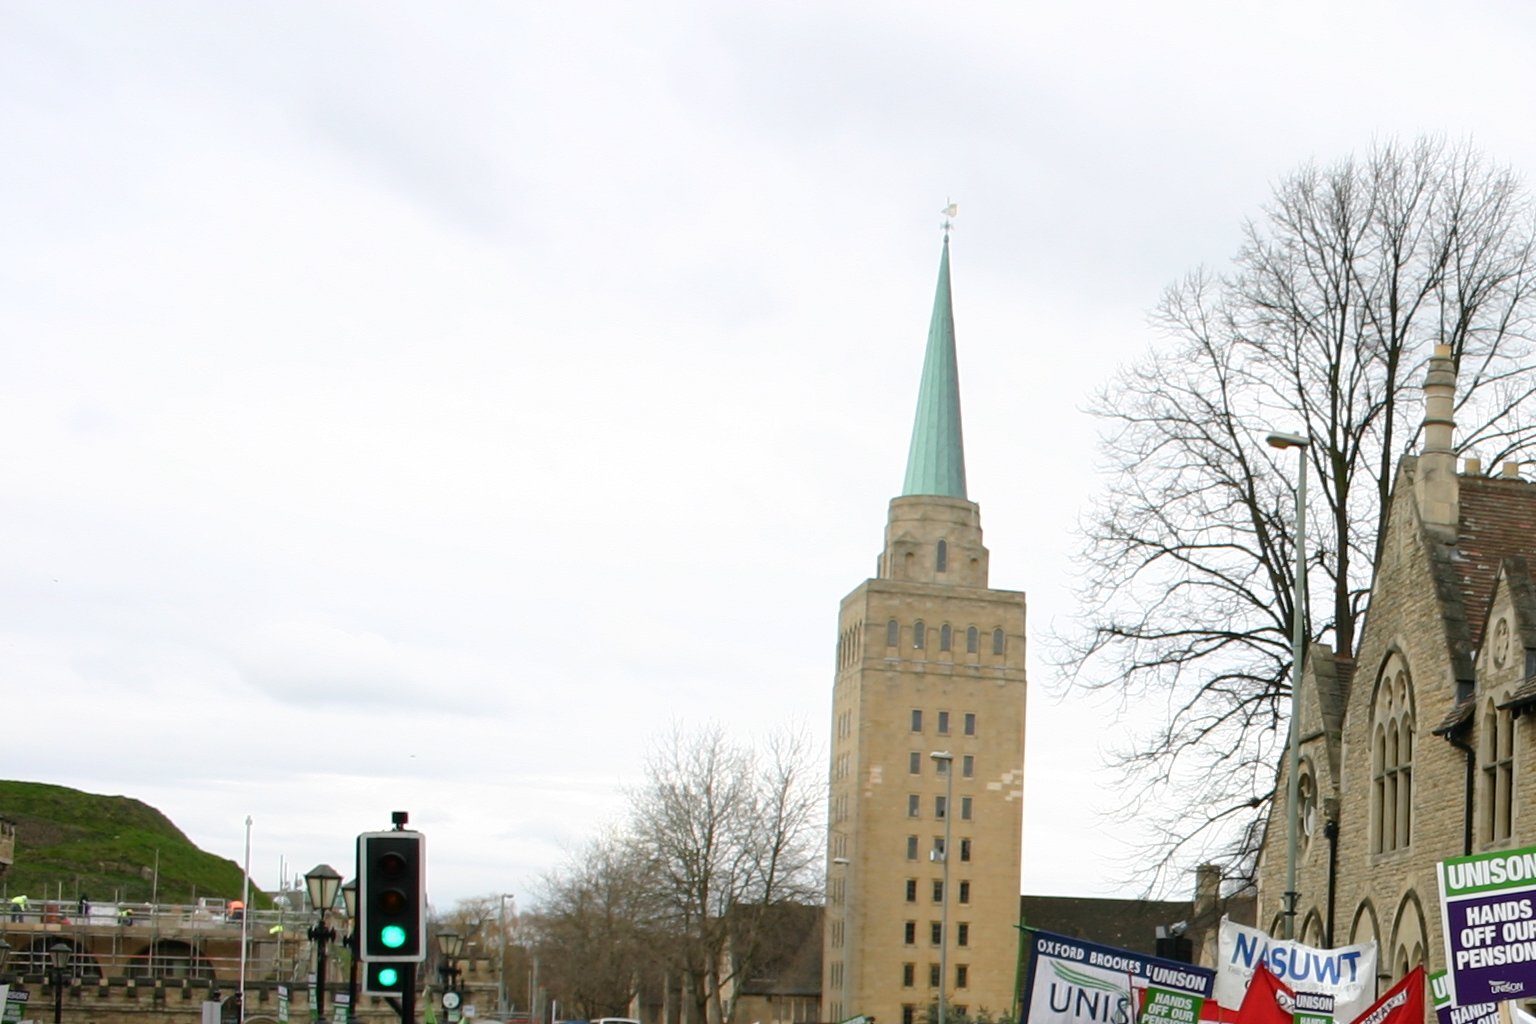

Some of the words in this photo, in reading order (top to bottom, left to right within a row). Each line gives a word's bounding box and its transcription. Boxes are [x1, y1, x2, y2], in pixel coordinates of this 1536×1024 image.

[1465, 899, 1534, 927] HANDS
[1460, 925, 1497, 948] OFF
[1037, 938, 1085, 960] OXFORD
[1089, 951, 1141, 974] BROOKES
[1231, 932, 1362, 985] NASUWT
[1153, 966, 1208, 992] UNISON
[1491, 981, 1524, 994] UNISON
[1148, 1003, 1169, 1017] OFF
[1171, 1008, 1195, 1022] OUR
[1154, 992, 1193, 1010] HANDS
[1296, 994, 1333, 1011] UNISON
